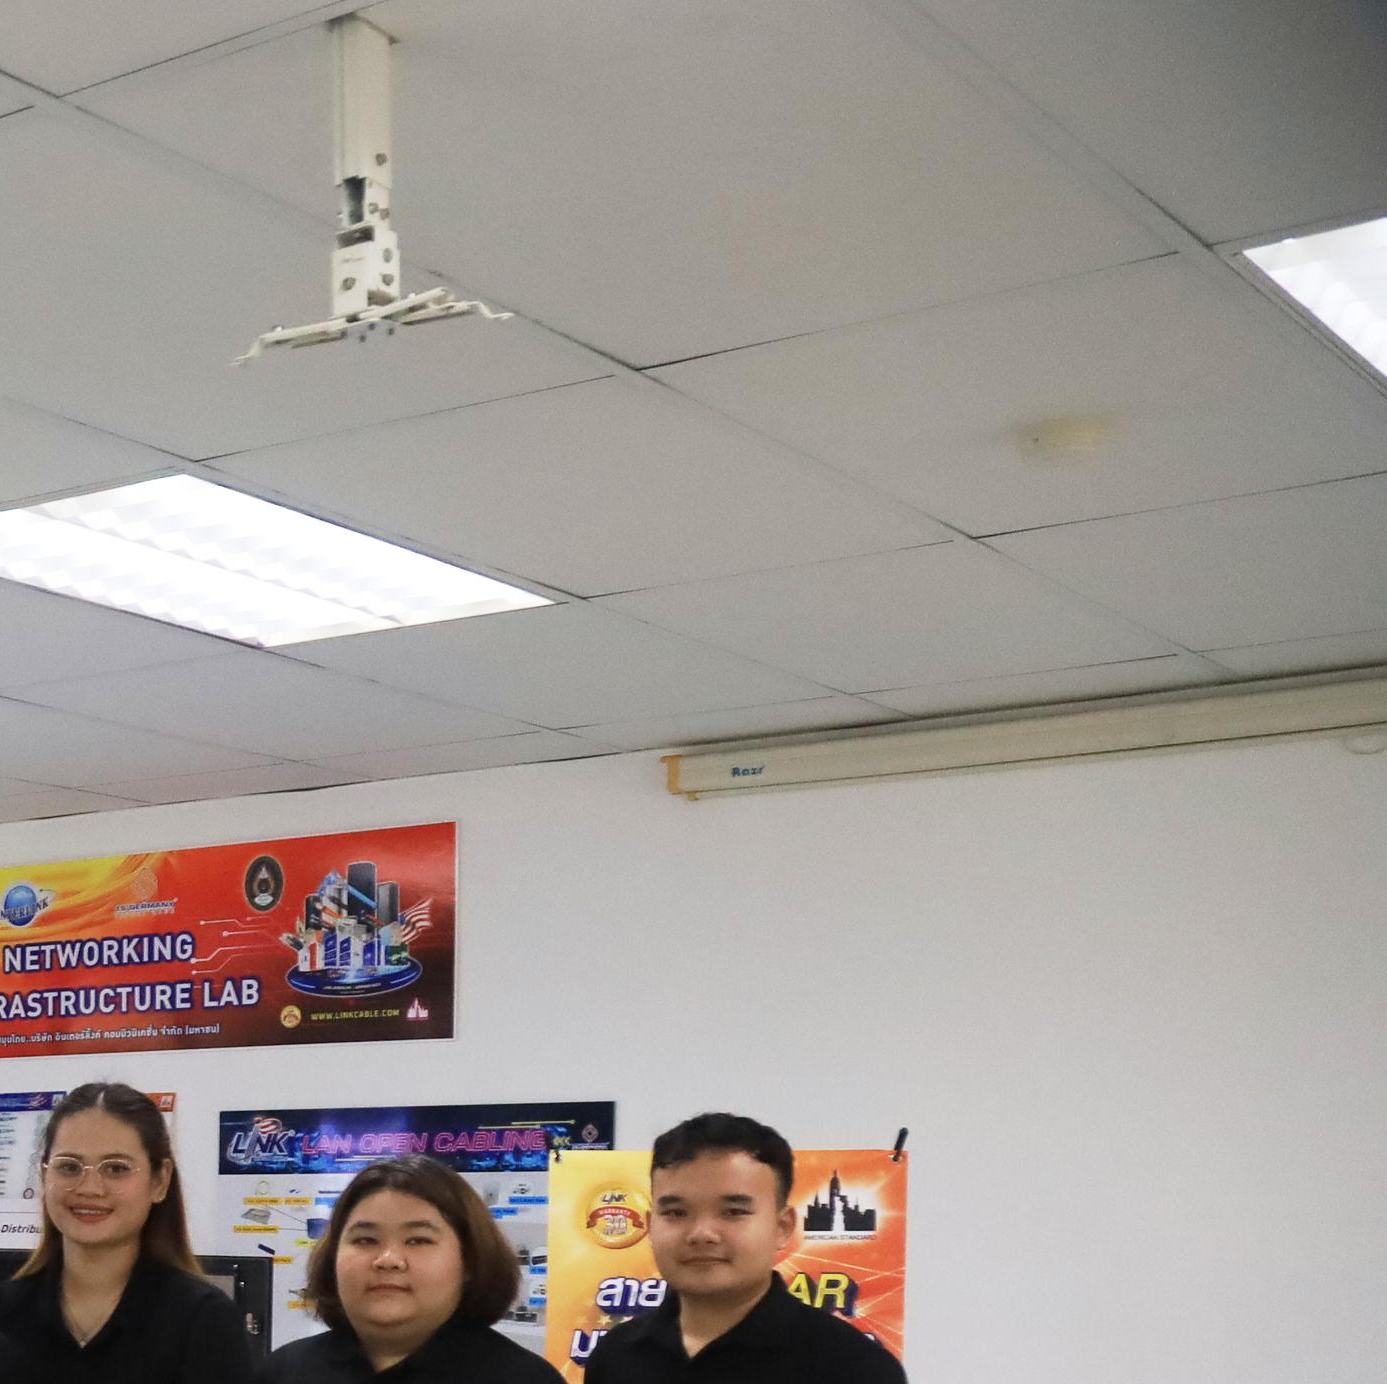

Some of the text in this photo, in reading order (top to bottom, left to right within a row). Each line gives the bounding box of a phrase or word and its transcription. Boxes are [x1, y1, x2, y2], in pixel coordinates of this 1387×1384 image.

[3, 934, 194, 972] NETWORKING
[203, 979, 260, 1008] LAB
[310, 1009, 400, 1021] WWW.LINKCABLE.COM
[230, 1123, 289, 1163] LINK
[302, 1133, 352, 1155] LAN
[360, 1131, 427, 1154] OPEN
[434, 1129, 546, 1152] CABLING
[1, 1224, 43, 1233] Distribu
[787, 1272, 850, 1309] AR
